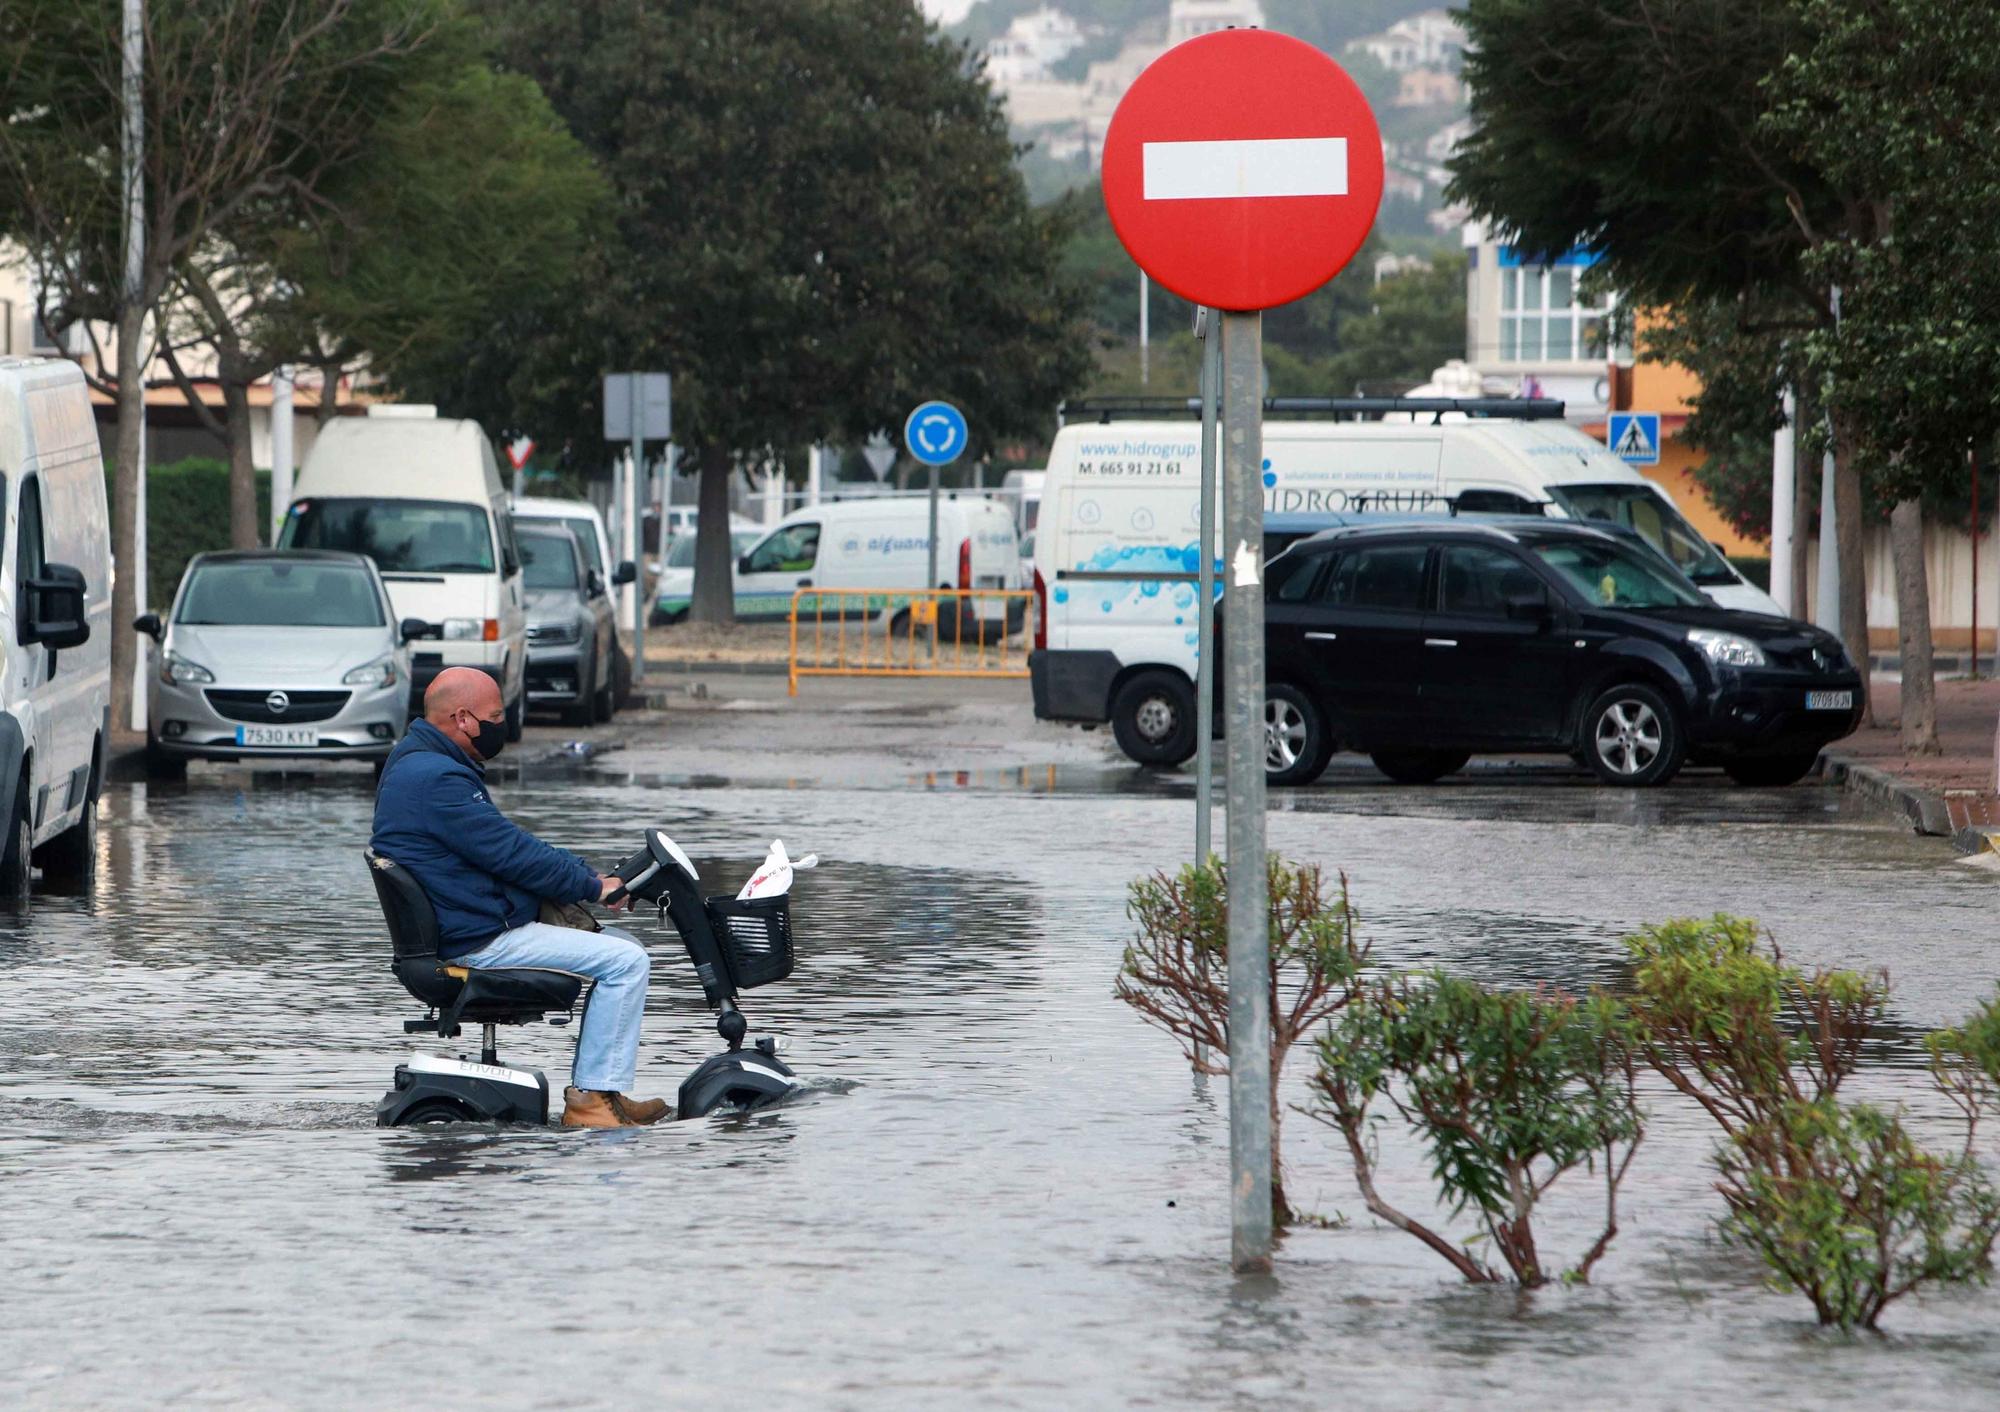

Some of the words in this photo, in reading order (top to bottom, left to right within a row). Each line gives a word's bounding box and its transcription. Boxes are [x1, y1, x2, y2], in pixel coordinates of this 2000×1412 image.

[1078, 462, 1096, 475] M.
[1100, 462, 1123, 475] 665
[1127, 462, 1142, 475] 91
[1147, 462, 1161, 475] 21
[1166, 462, 1181, 475] 61
[1272, 489, 1434, 512] IDROGRUP
[247, 728, 282, 742] 7530
[288, 729, 314, 742] KYY
